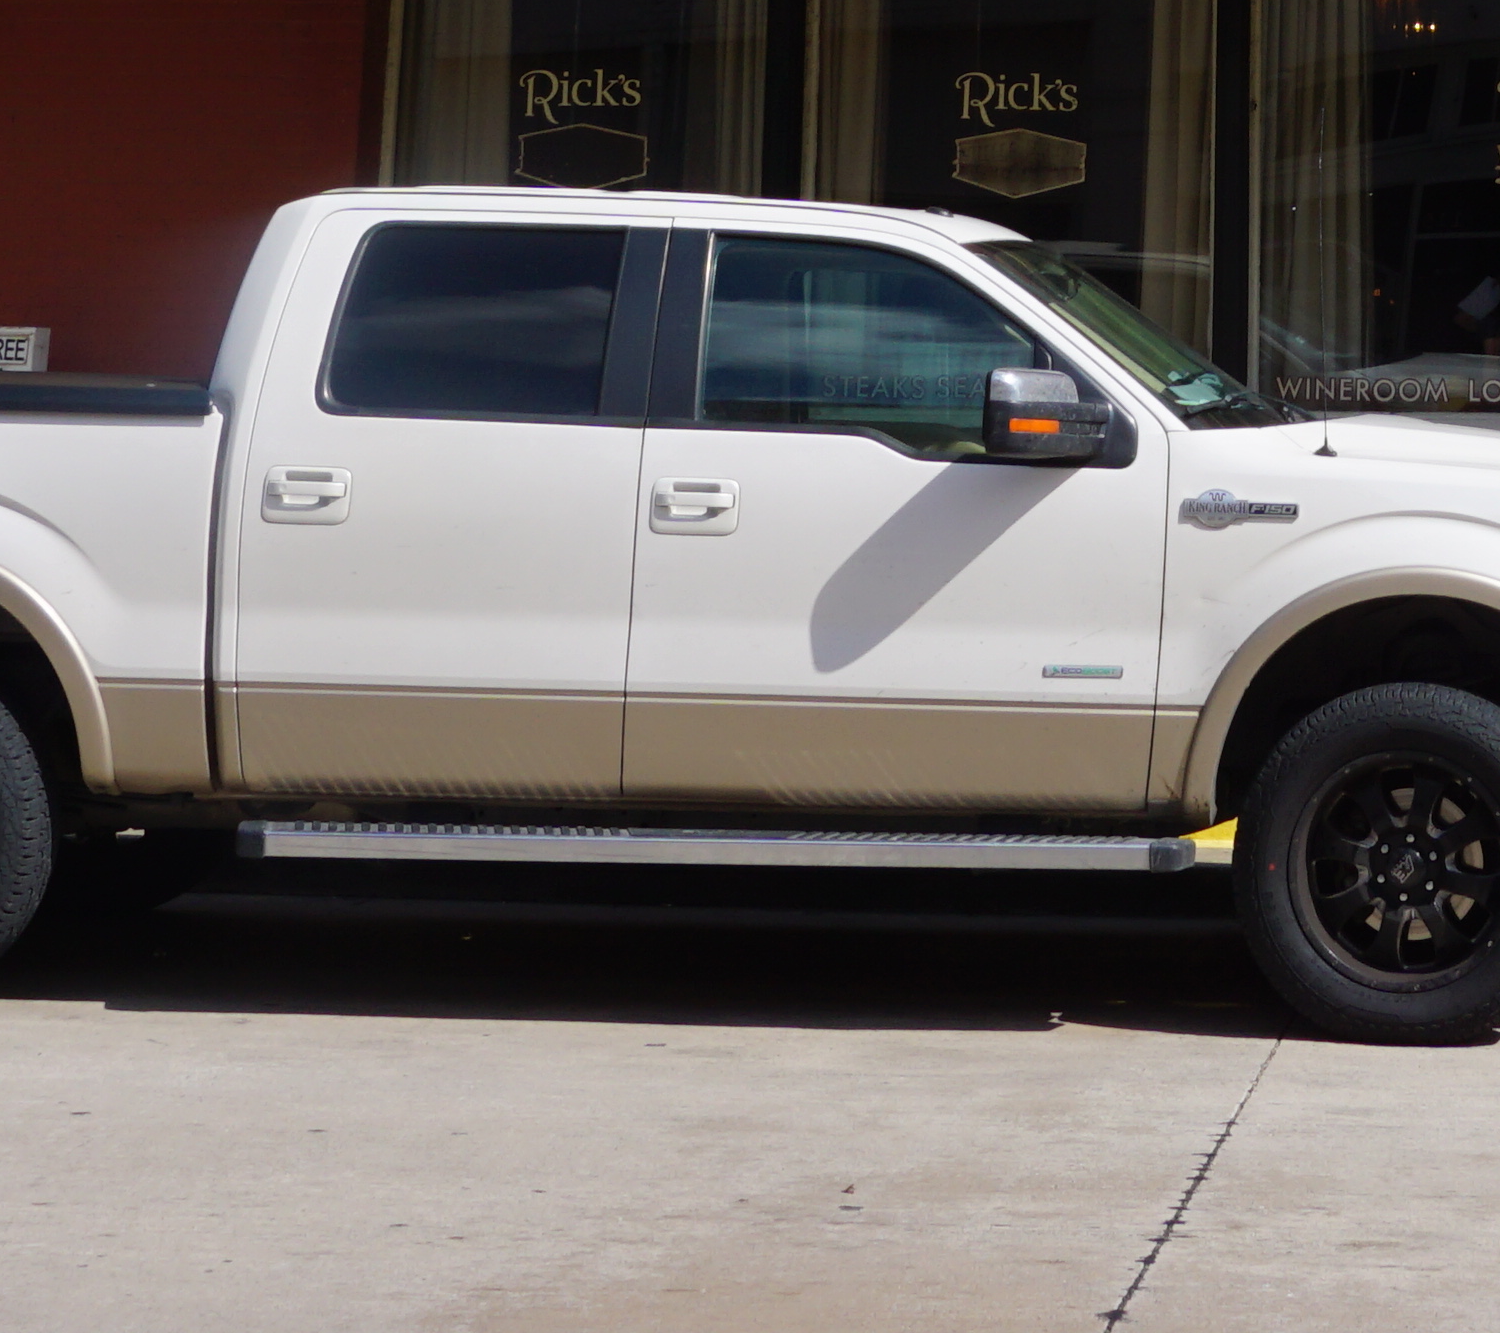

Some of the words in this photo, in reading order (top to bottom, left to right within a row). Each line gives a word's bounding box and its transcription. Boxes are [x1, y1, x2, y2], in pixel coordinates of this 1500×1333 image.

[519, 69, 642, 124] Rick's
[955, 72, 1078, 127] Rick's
[822, 375, 926, 400] STEAKS
[1276, 377, 1450, 404] WINEROOM
[1187, 500, 1213, 514] KING
[1213, 501, 1246, 515] RANCH
